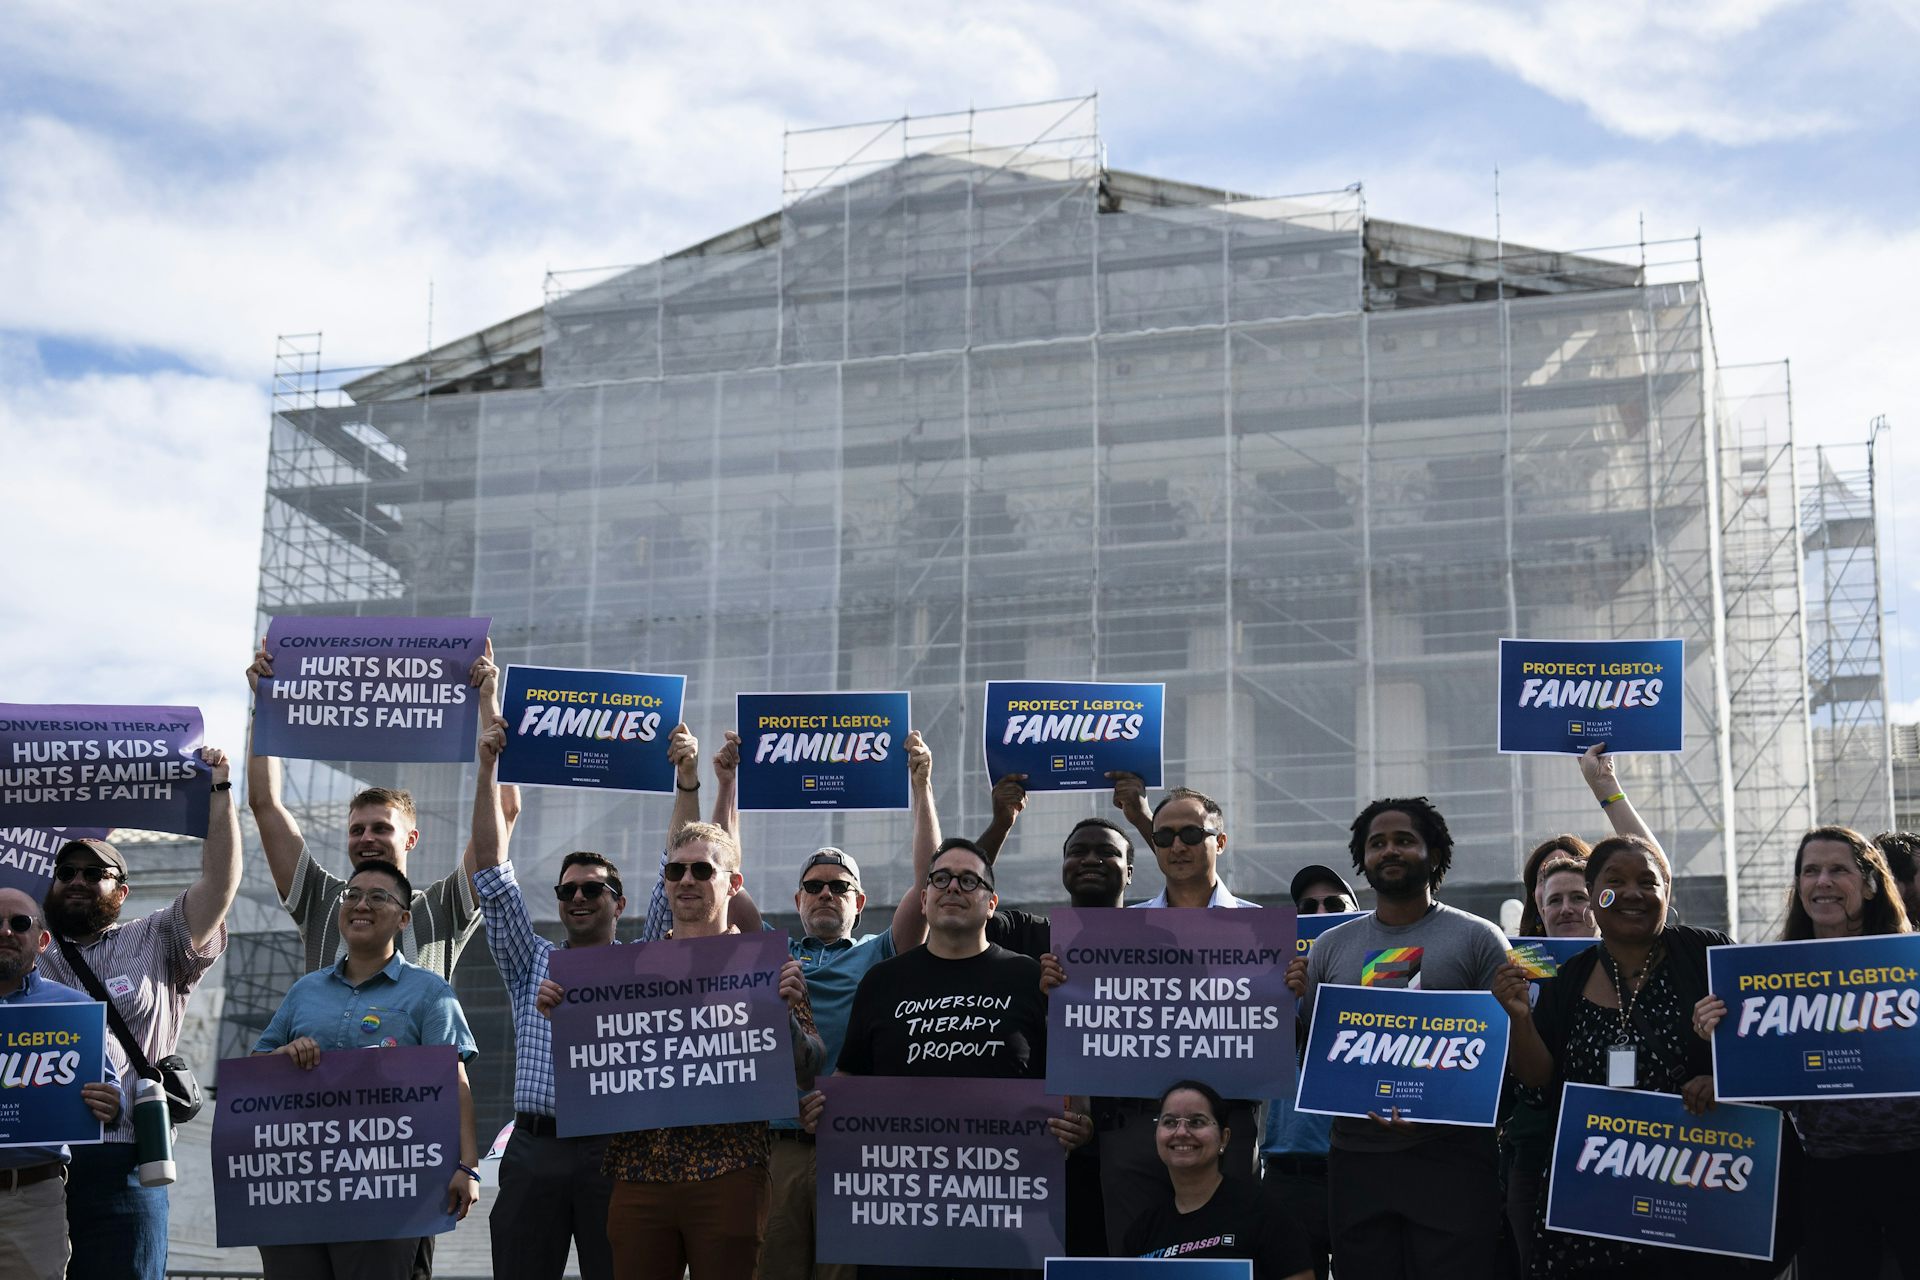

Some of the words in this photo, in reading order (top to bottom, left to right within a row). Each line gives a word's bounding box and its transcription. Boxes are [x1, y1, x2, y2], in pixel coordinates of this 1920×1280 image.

[279, 637, 392, 648] CONVERSION
[397, 638, 473, 649] THERAPY
[300, 657, 379, 677] HURTS
[387, 658, 443, 679] KIDS
[1523, 662, 1596, 675] PROTECT
[1601, 663, 1663, 675] LGBTQ+
[272, 680, 353, 701] HURTS
[360, 682, 466, 704] FAMILIES
[526, 689, 598, 704] PROTECT
[602, 693, 663, 708] LGBTQ+
[1519, 679, 1663, 710] FAMILIES
[288, 704, 369, 727] HURTS
[376, 708, 443, 728] FAITH
[1008, 700, 1079, 711] PROTECT
[1083, 700, 1144, 710] LGBTQ+
[0, 720, 108, 731] ONVERSION
[110, 721, 191, 733] THERAPY
[518, 705, 661, 742] FAMILIES
[759, 716, 828, 728] PROTECT
[832, 716, 890, 728] LGBTQ+
[1003, 714, 1143, 745] FAMILIES
[13, 740, 100, 763] HURTS
[107, 740, 168, 759] KIDS
[755, 732, 891, 763] FAMILIES
[0, 767, 73, 787] URTS
[81, 761, 196, 783] FAMILIES
[5, 787, 91, 803] HURTS
[99, 783, 172, 800] FAITH
[1066, 948, 1193, 964] CONVERSION
[1198, 949, 1281, 965] THERAPY
[567, 978, 692, 1004] CONVERSION
[697, 971, 775, 993] THERAPY
[1094, 977, 1182, 1001] HURTS
[1190, 977, 1250, 1001] KIDS
[1740, 971, 1832, 991] PROTECT
[1839, 966, 1918, 985] LGBTQ+
[895, 995, 1011, 1018] CONVERSION
[1065, 1005, 1153, 1029] HURTS
[1161, 1006, 1278, 1029] FAMILIES
[1737, 988, 1920, 1037] FAMILIES
[596, 1009, 684, 1038] HURTS
[691, 1002, 749, 1030] KIDS
[907, 1016, 1000, 1036] THERAPY
[1339, 1011, 1418, 1029] PROTECT
[1422, 1017, 1488, 1033] LGBTQ+
[8, 1031, 81, 1046] LGBTQ+
[569, 1040, 656, 1069] HURTS
[665, 1028, 777, 1060] FAMILIES
[1083, 1034, 1170, 1057] HURTS
[1179, 1035, 1253, 1059] FAITH
[1327, 1030, 1486, 1071] FAMILIES
[907, 1041, 1005, 1064] DROPOUT
[590, 1065, 675, 1096] HURTS
[683, 1059, 756, 1087] FAITH
[230, 1090, 350, 1114] CONVERSION
[356, 1086, 443, 1105] THERAPY
[254, 1120, 341, 1148] HURTS
[349, 1116, 413, 1142] KIDS
[833, 1116, 960, 1134] CONVERSION
[965, 1119, 1049, 1136] THERAPY
[1586, 1115, 1674, 1139] PROTECT
[1679, 1128, 1755, 1149] LGBTQ+
[228, 1151, 313, 1178] HURTS
[321, 1143, 443, 1173] FAMILIES
[862, 1145, 949, 1169] HURTS
[957, 1147, 1019, 1171] KIDS
[1576, 1136, 1753, 1192] FAMILIES
[248, 1179, 332, 1206] HURTS
[339, 1174, 416, 1201] FAITH
[834, 1173, 920, 1197] HURTS
[929, 1174, 1048, 1200] FAMILIES
[852, 1201, 938, 1227] HURTS
[947, 1203, 1022, 1228] FAITH
[1655, 1206, 1687, 1215] RIGHTS
[1656, 1199, 1688, 1208] HUMAN
[1655, 1214, 1687, 1223] CAMPAIGN
[1164, 1245, 1179, 1257] BE
[1179, 1236, 1220, 1254] ERASED
